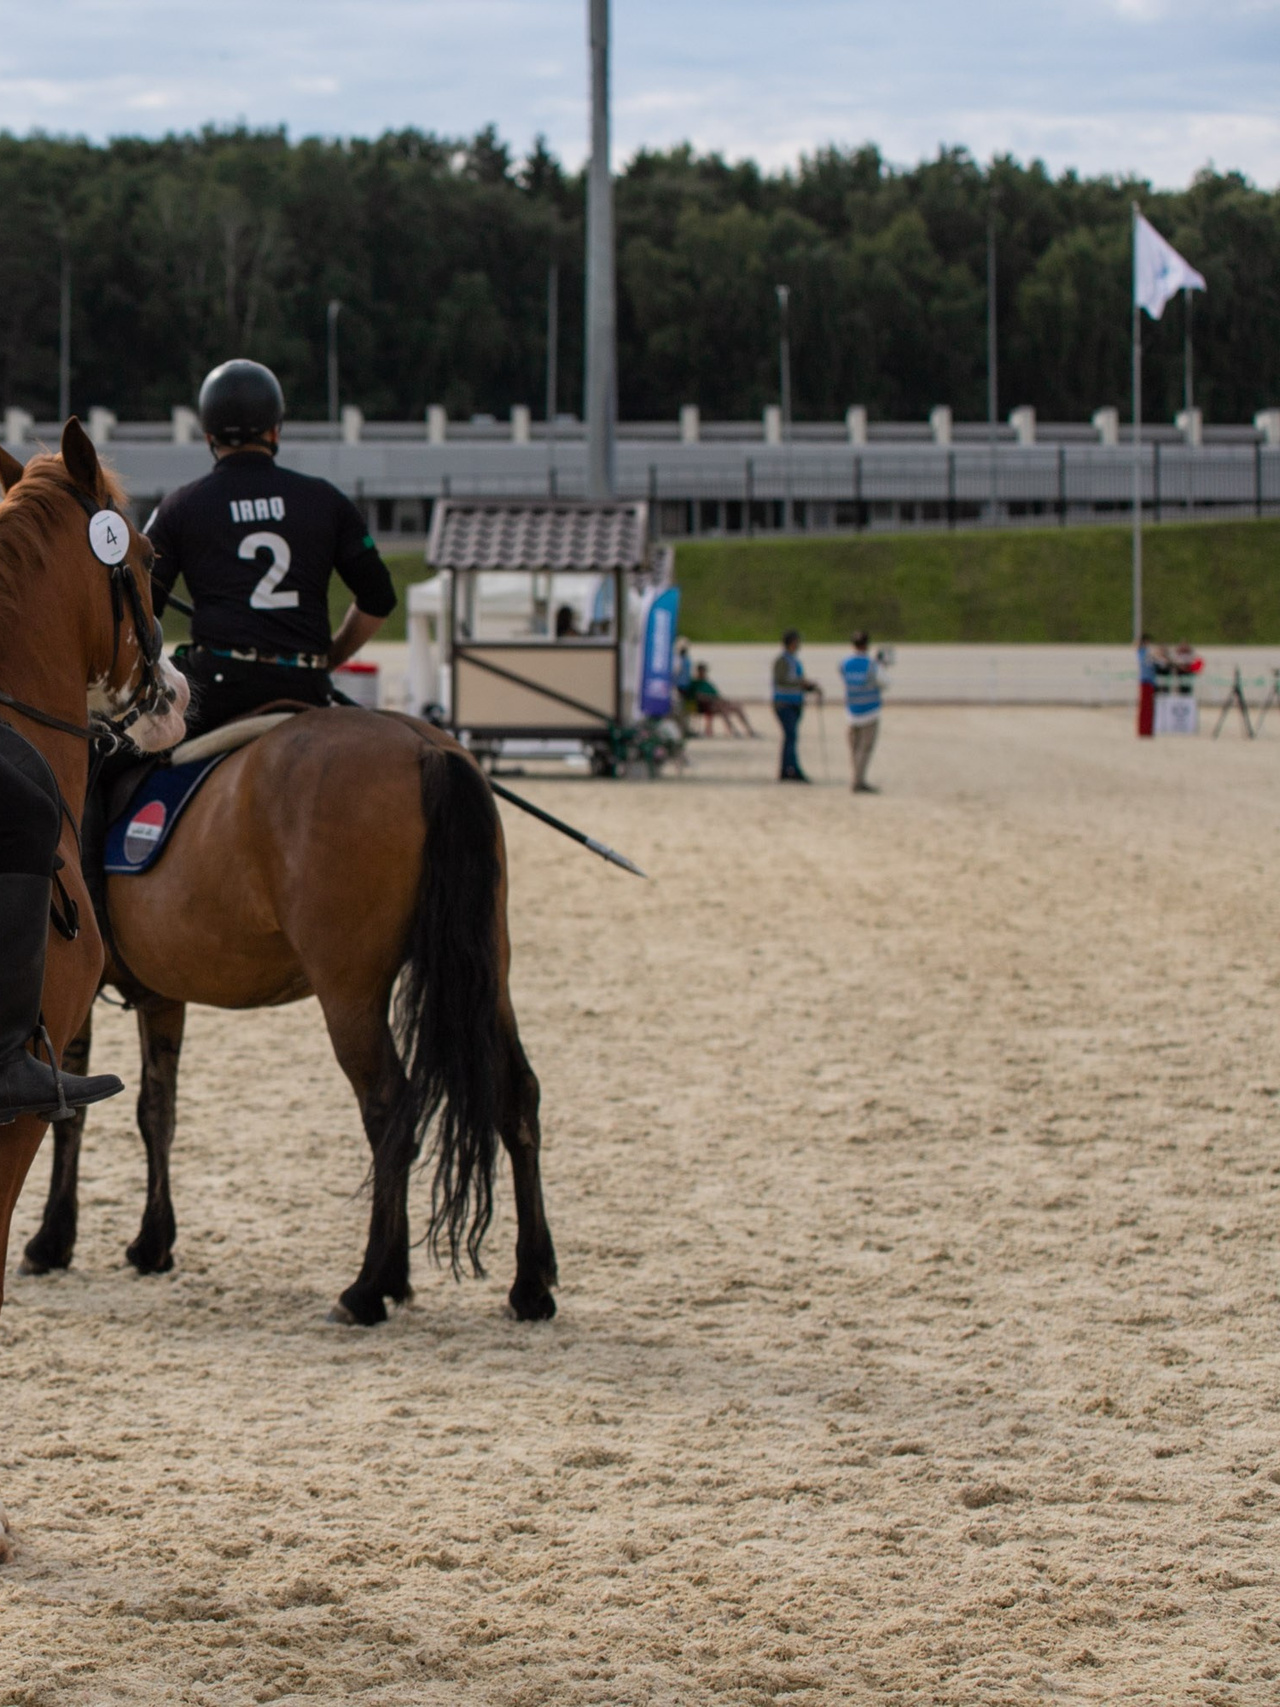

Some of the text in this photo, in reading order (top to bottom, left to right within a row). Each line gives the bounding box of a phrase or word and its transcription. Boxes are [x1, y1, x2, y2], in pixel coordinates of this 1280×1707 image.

[230, 496, 286, 523] IRAQ
[106, 525, 118, 545] 4
[237, 531, 300, 610] 2
